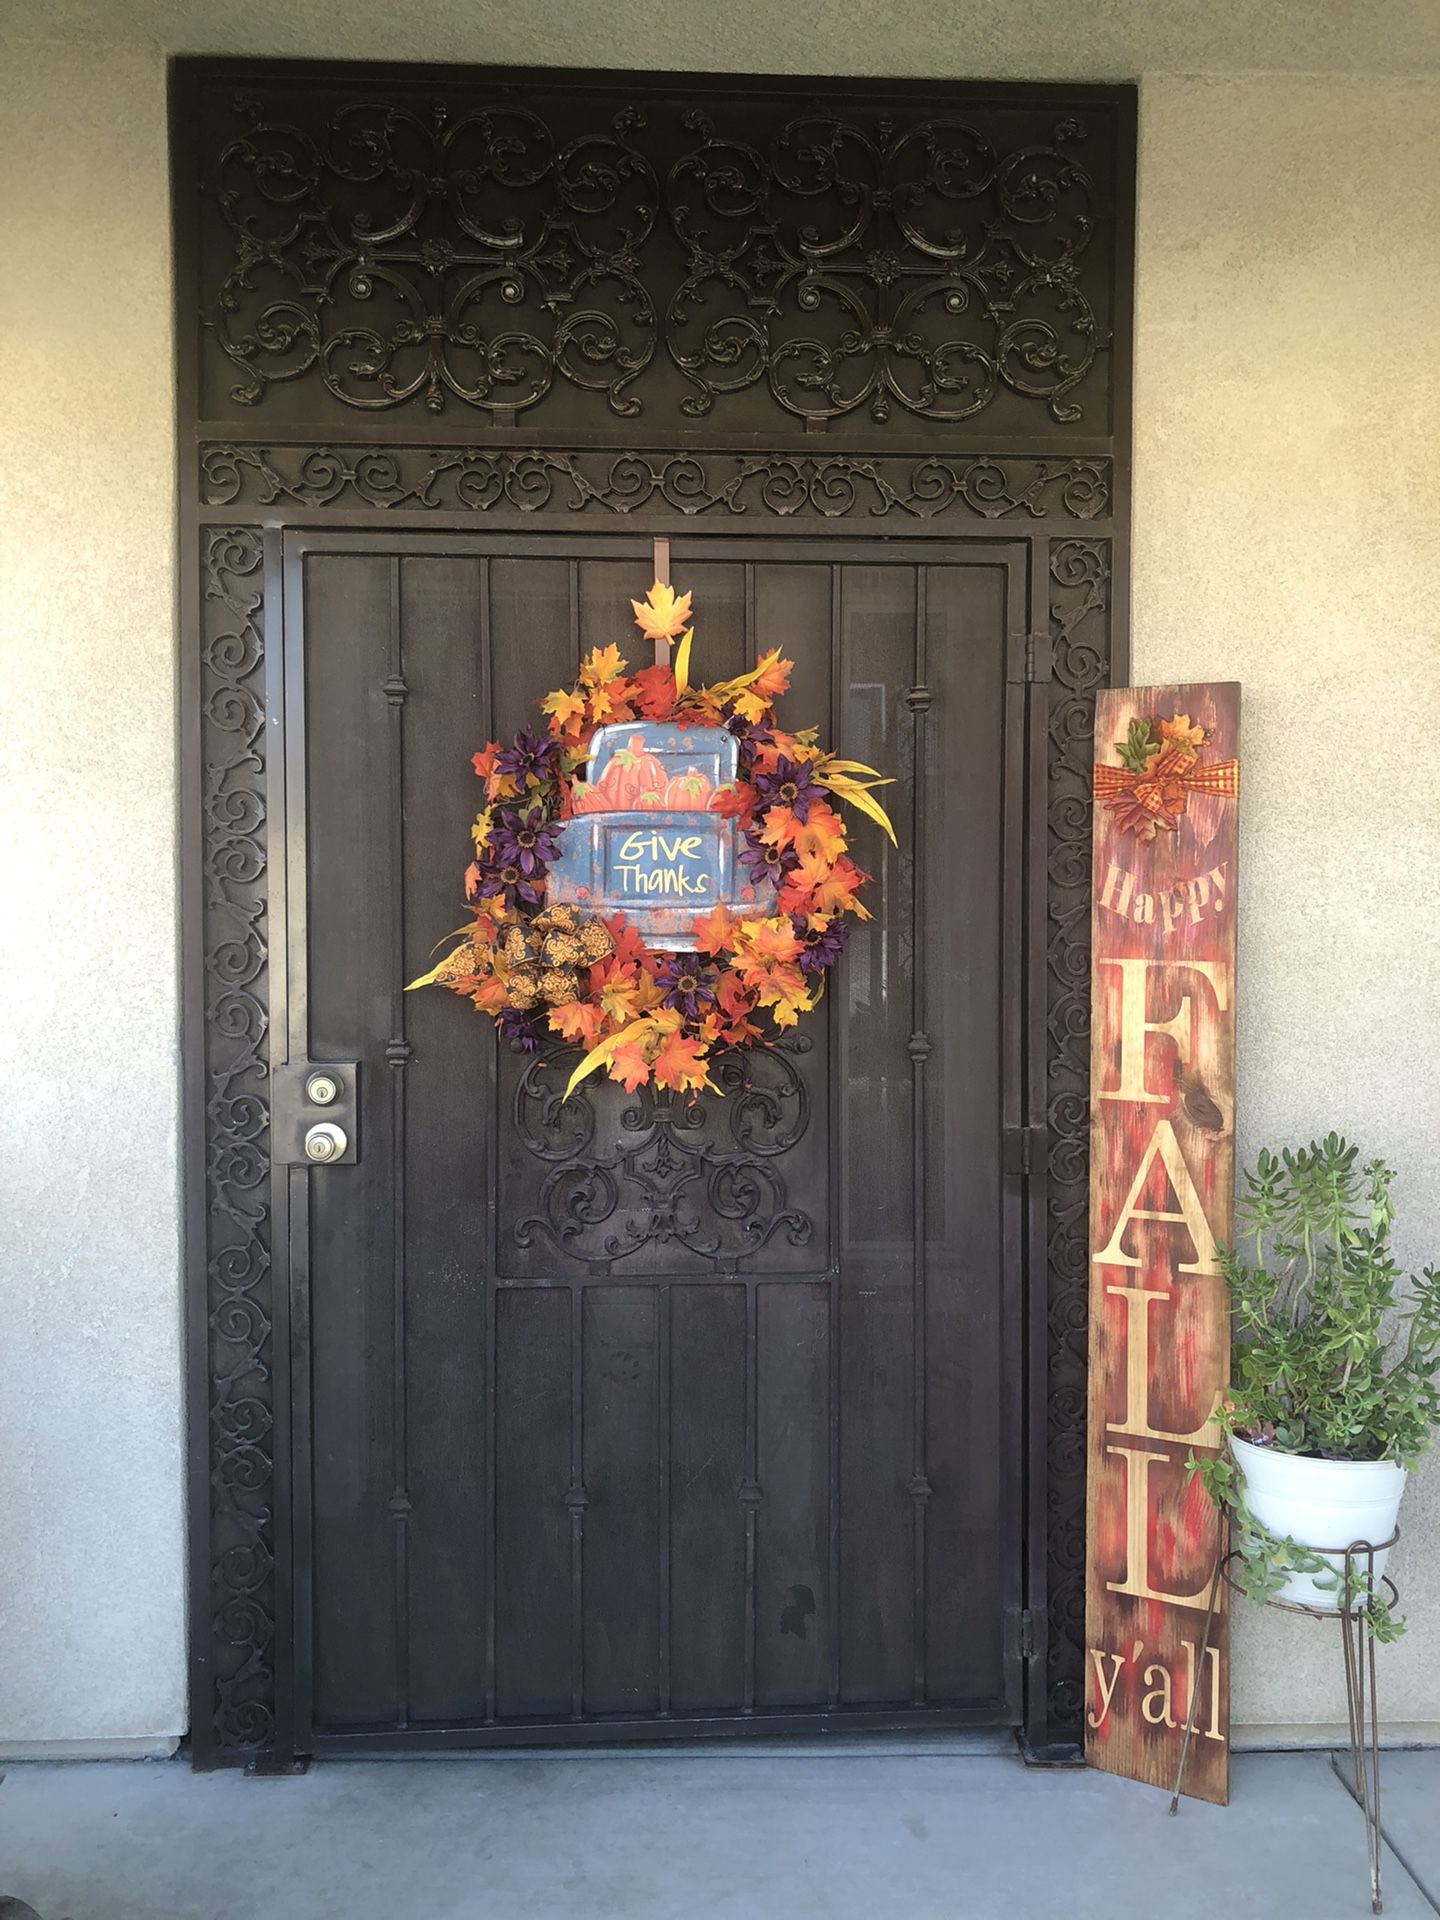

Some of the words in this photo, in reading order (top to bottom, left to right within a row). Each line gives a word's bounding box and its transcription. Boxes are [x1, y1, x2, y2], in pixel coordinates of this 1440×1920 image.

[613, 864, 709, 897] Thanks
[619, 831, 702, 861] Give
[1097, 861, 1229, 934] Happy
[1092, 957, 1228, 1614] FALL
[1087, 1639, 1225, 1742] y'all
